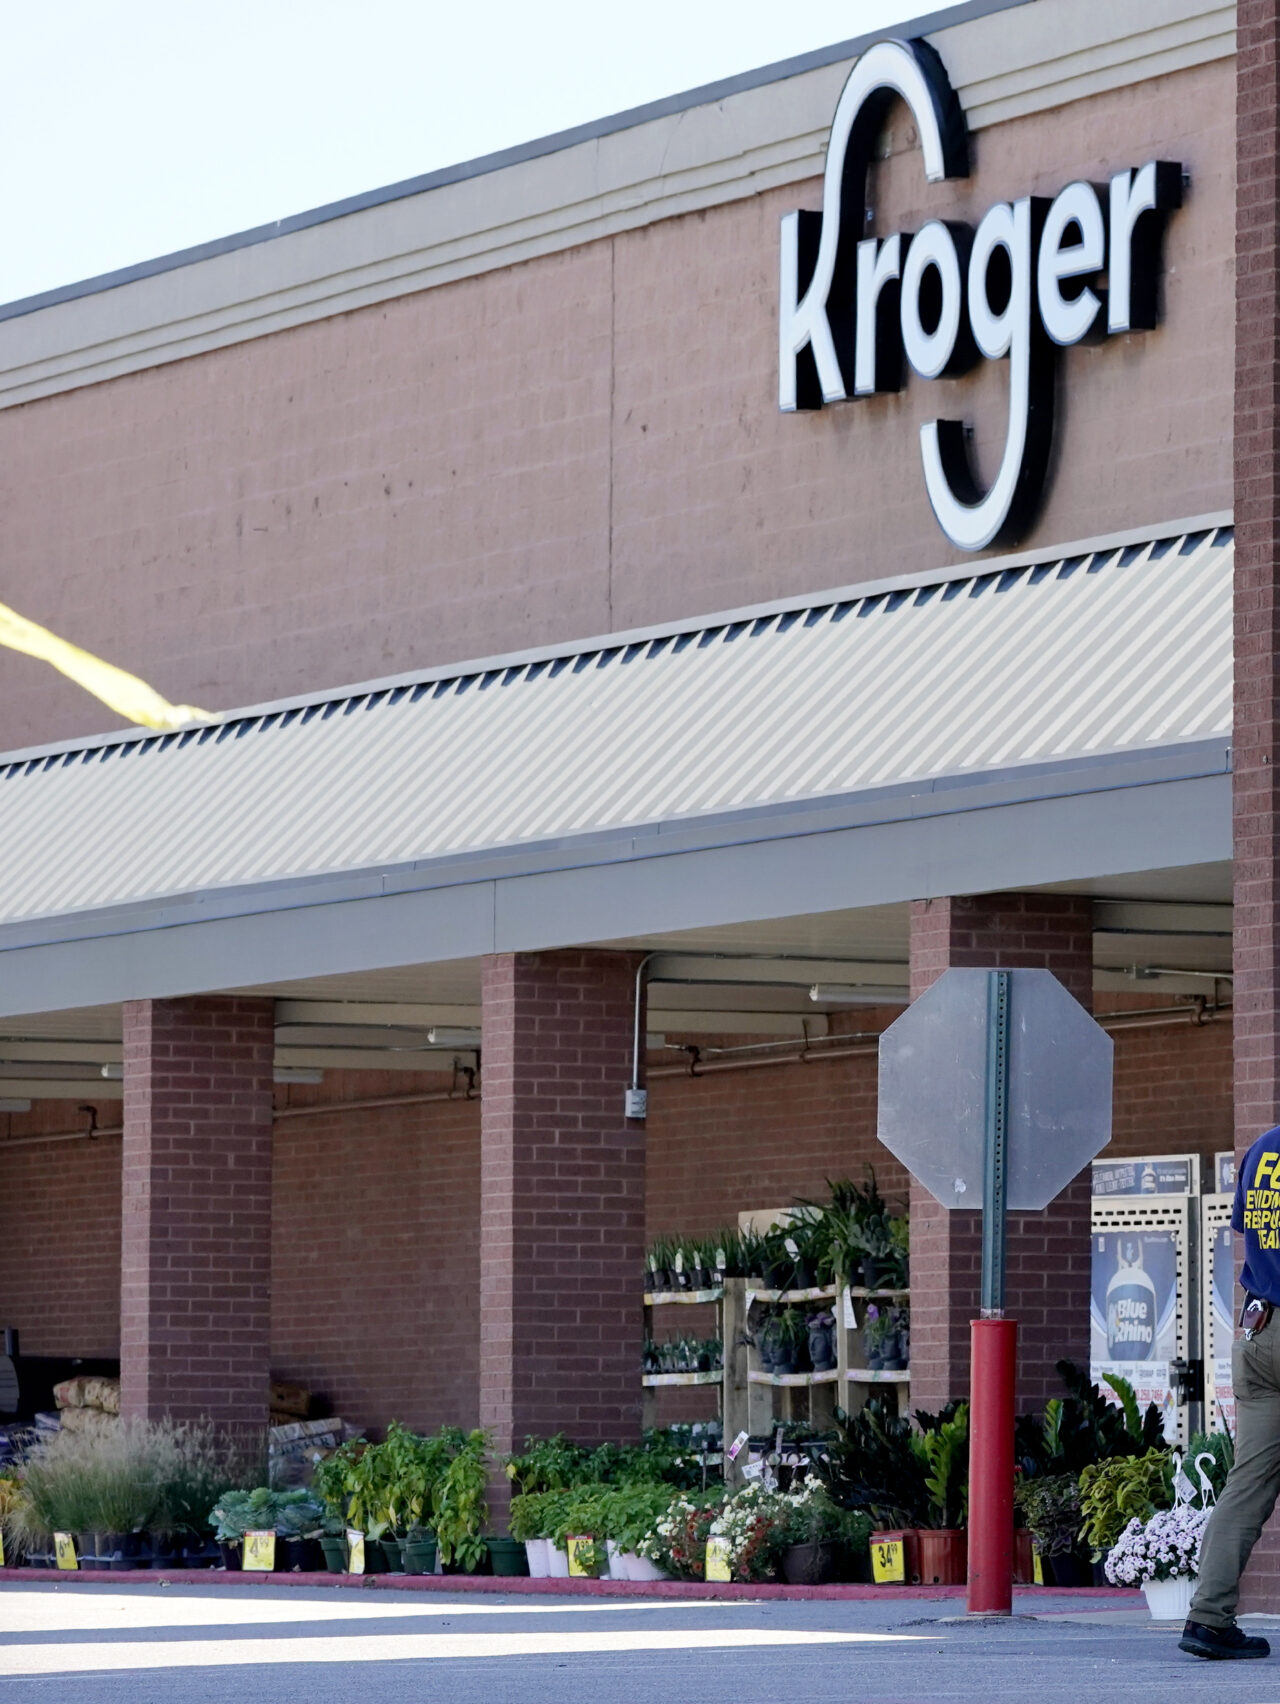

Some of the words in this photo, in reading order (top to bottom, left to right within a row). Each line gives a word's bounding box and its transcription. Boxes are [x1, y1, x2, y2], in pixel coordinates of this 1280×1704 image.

[779, 39, 1158, 552] Kroger
[1117, 1298, 1148, 1320] Blue
[1115, 1320, 1153, 1343] Rhino
